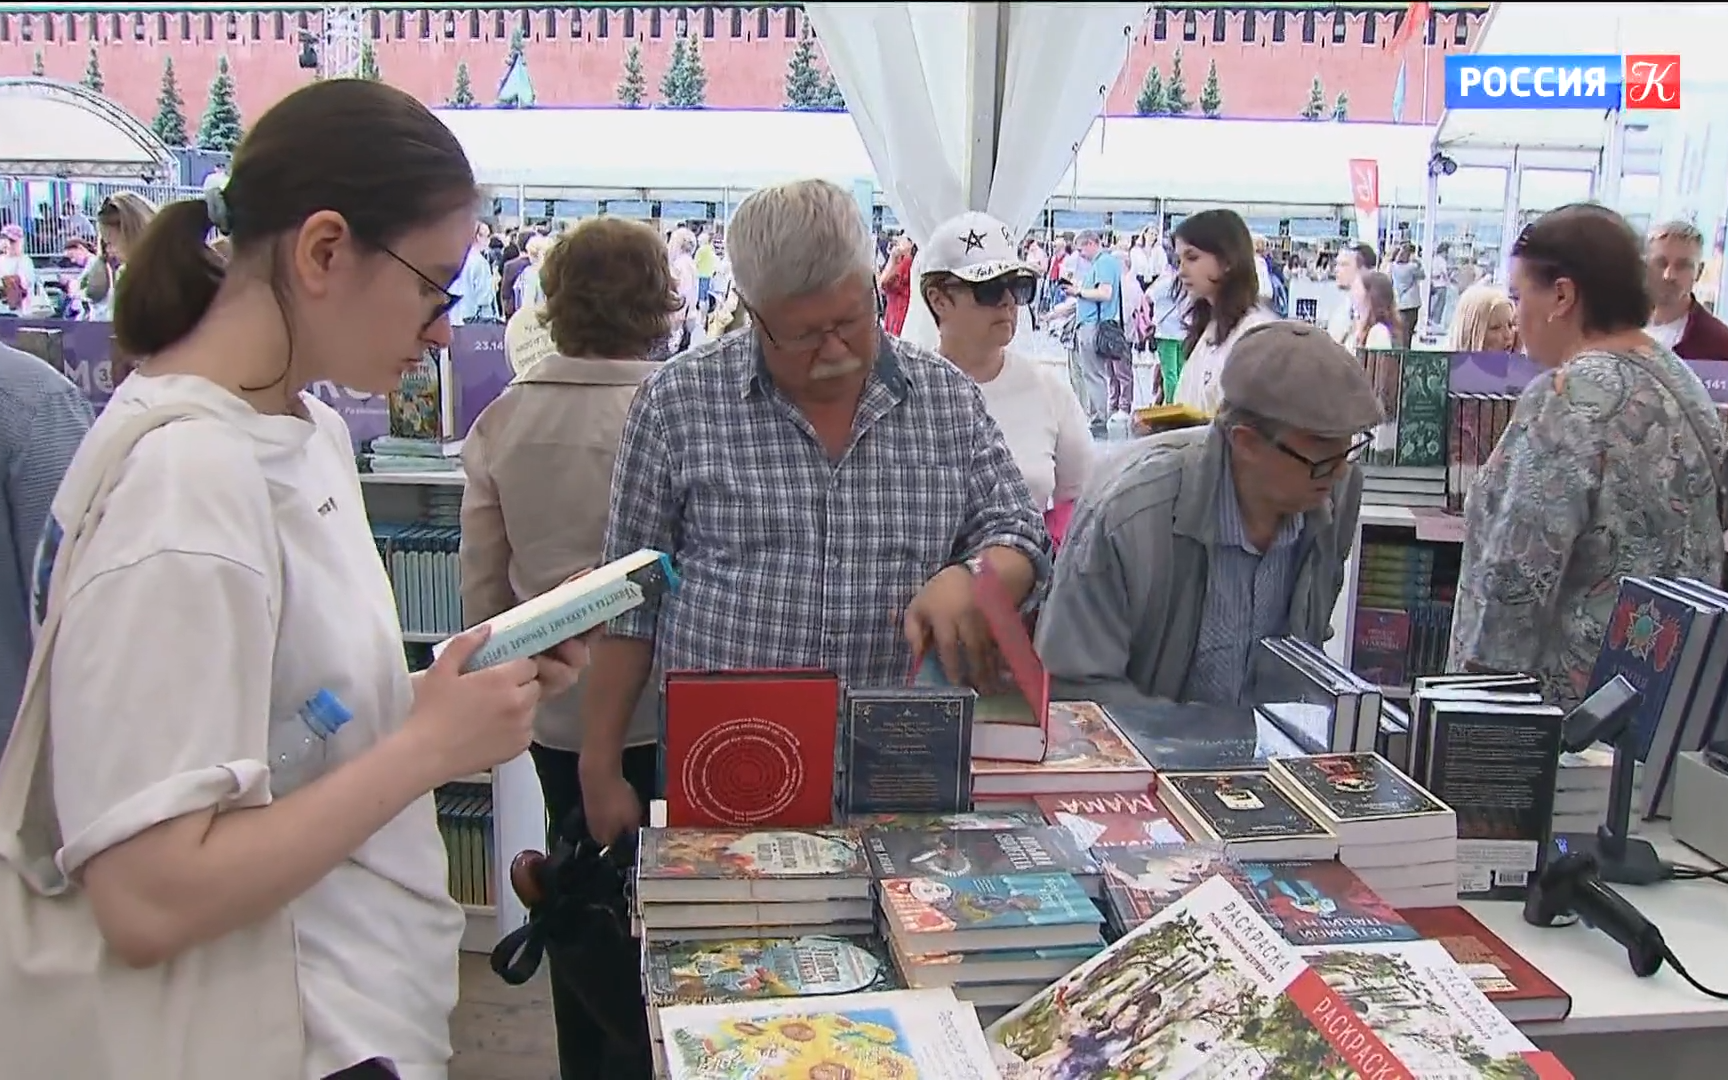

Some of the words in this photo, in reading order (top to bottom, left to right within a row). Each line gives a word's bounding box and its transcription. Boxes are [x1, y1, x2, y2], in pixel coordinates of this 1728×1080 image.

[1058, 793, 1156, 813] МАМА
[1221, 901, 1290, 972] РАСКРАСКА
[1311, 996, 1403, 1080] РАСКРАСК
